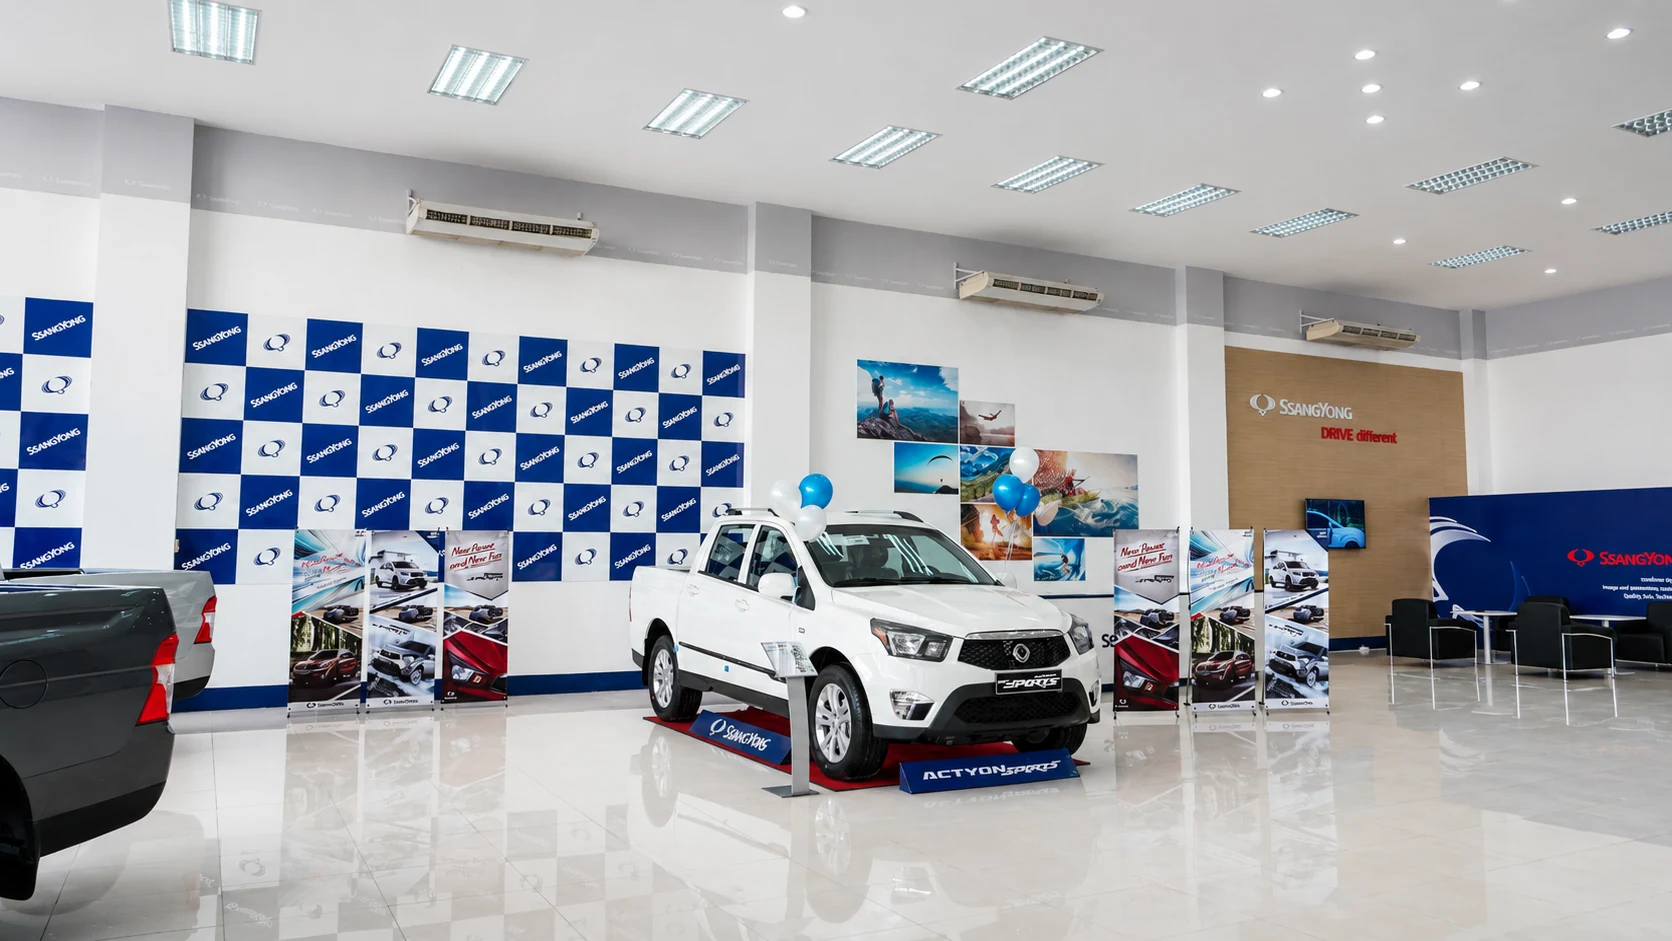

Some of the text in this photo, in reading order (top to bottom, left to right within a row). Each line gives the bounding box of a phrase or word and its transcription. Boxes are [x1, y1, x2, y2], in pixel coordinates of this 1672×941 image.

[1321, 427, 1398, 444] DRIVE different
[1599, 551, 1672, 566] SSANGYON
[923, 760, 1061, 780] ACTYON SPORTS
